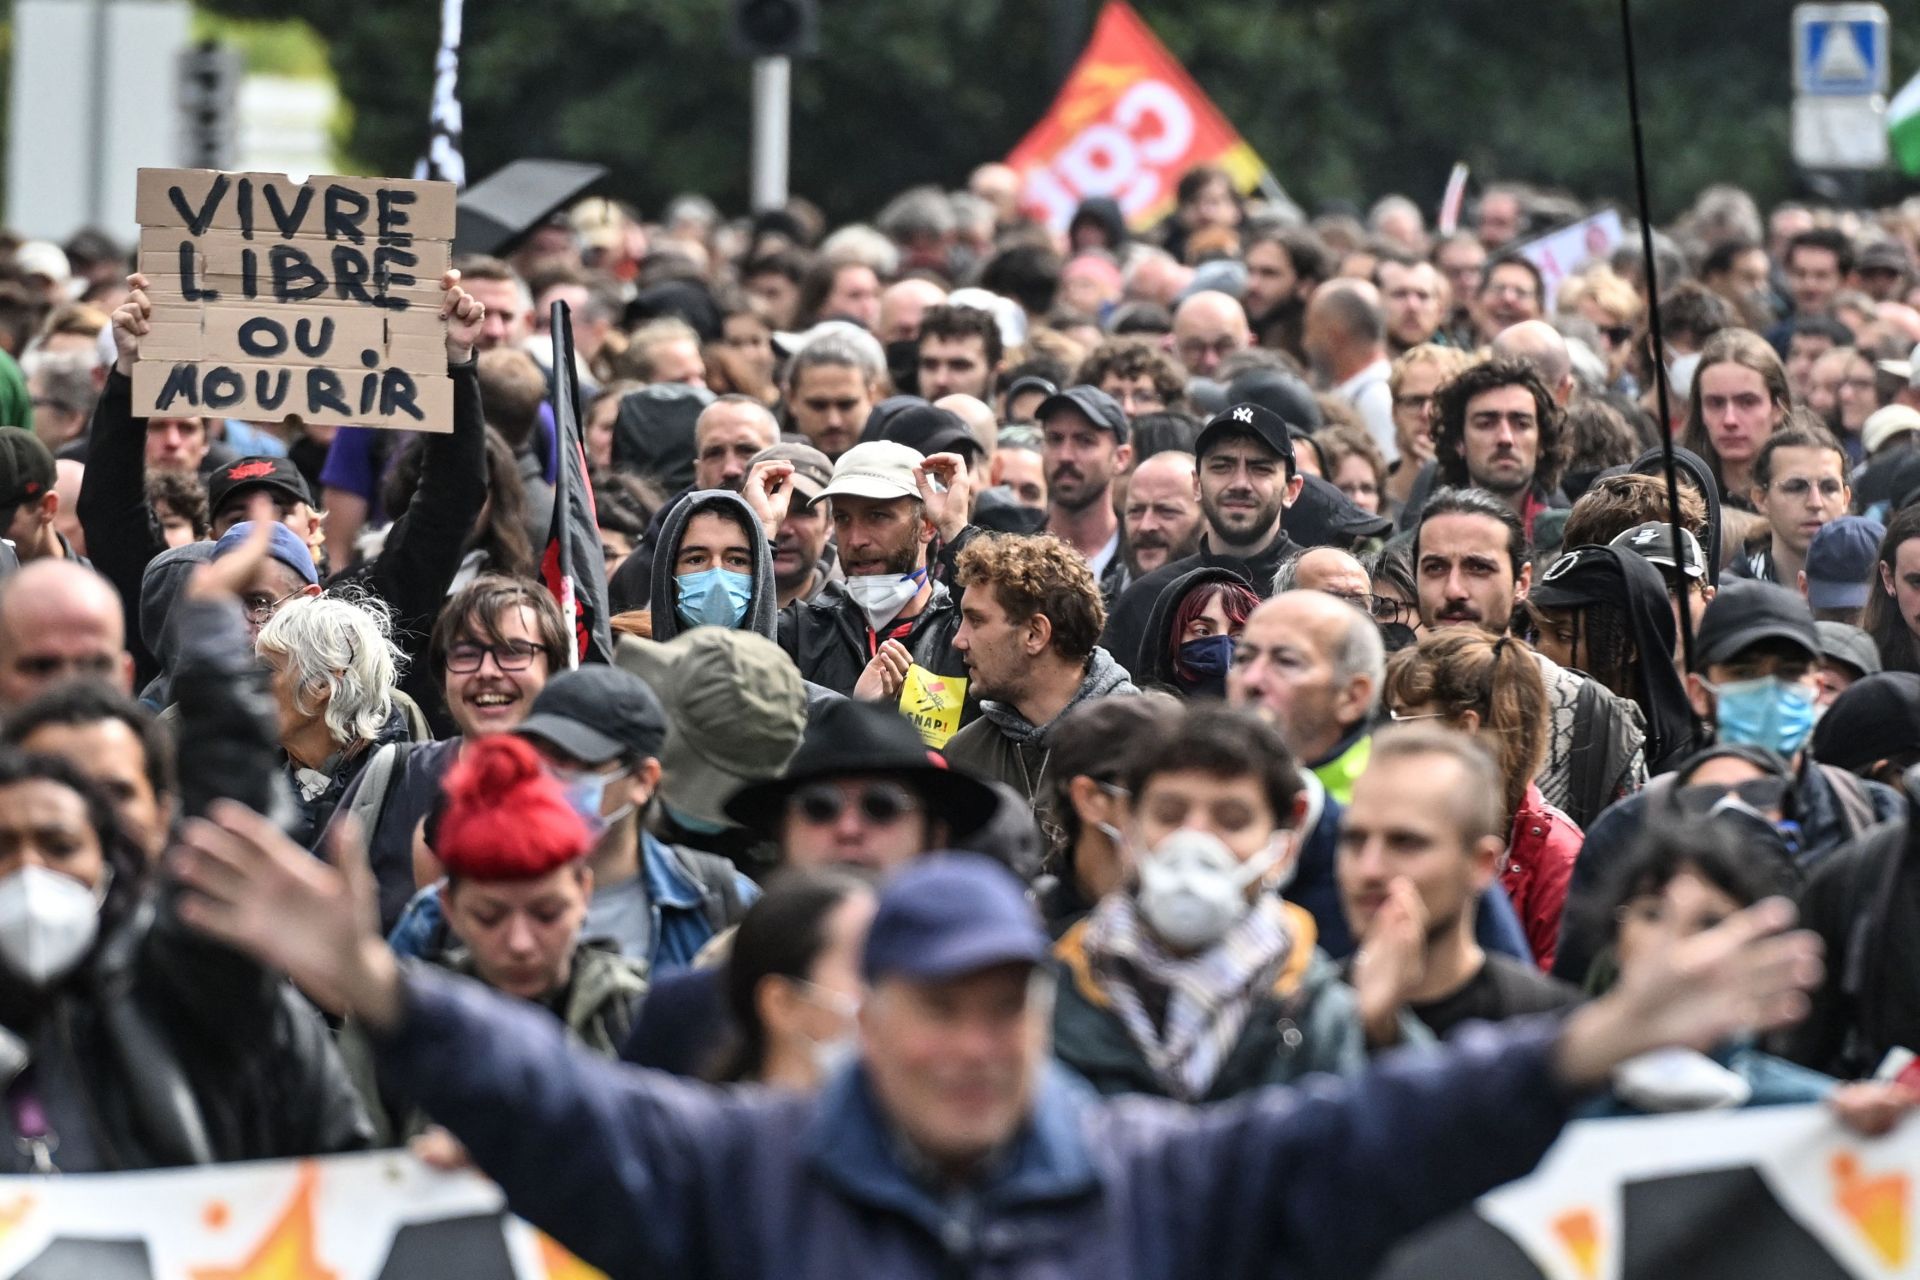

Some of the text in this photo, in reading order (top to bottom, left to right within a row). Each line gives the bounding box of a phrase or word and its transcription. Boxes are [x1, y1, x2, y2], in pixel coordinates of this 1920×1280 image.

[169, 174, 417, 246] VIVRE
[178, 240, 418, 311] LIBRE
[238, 316, 334, 358] OU
[1233, 407, 1253, 424] NY
